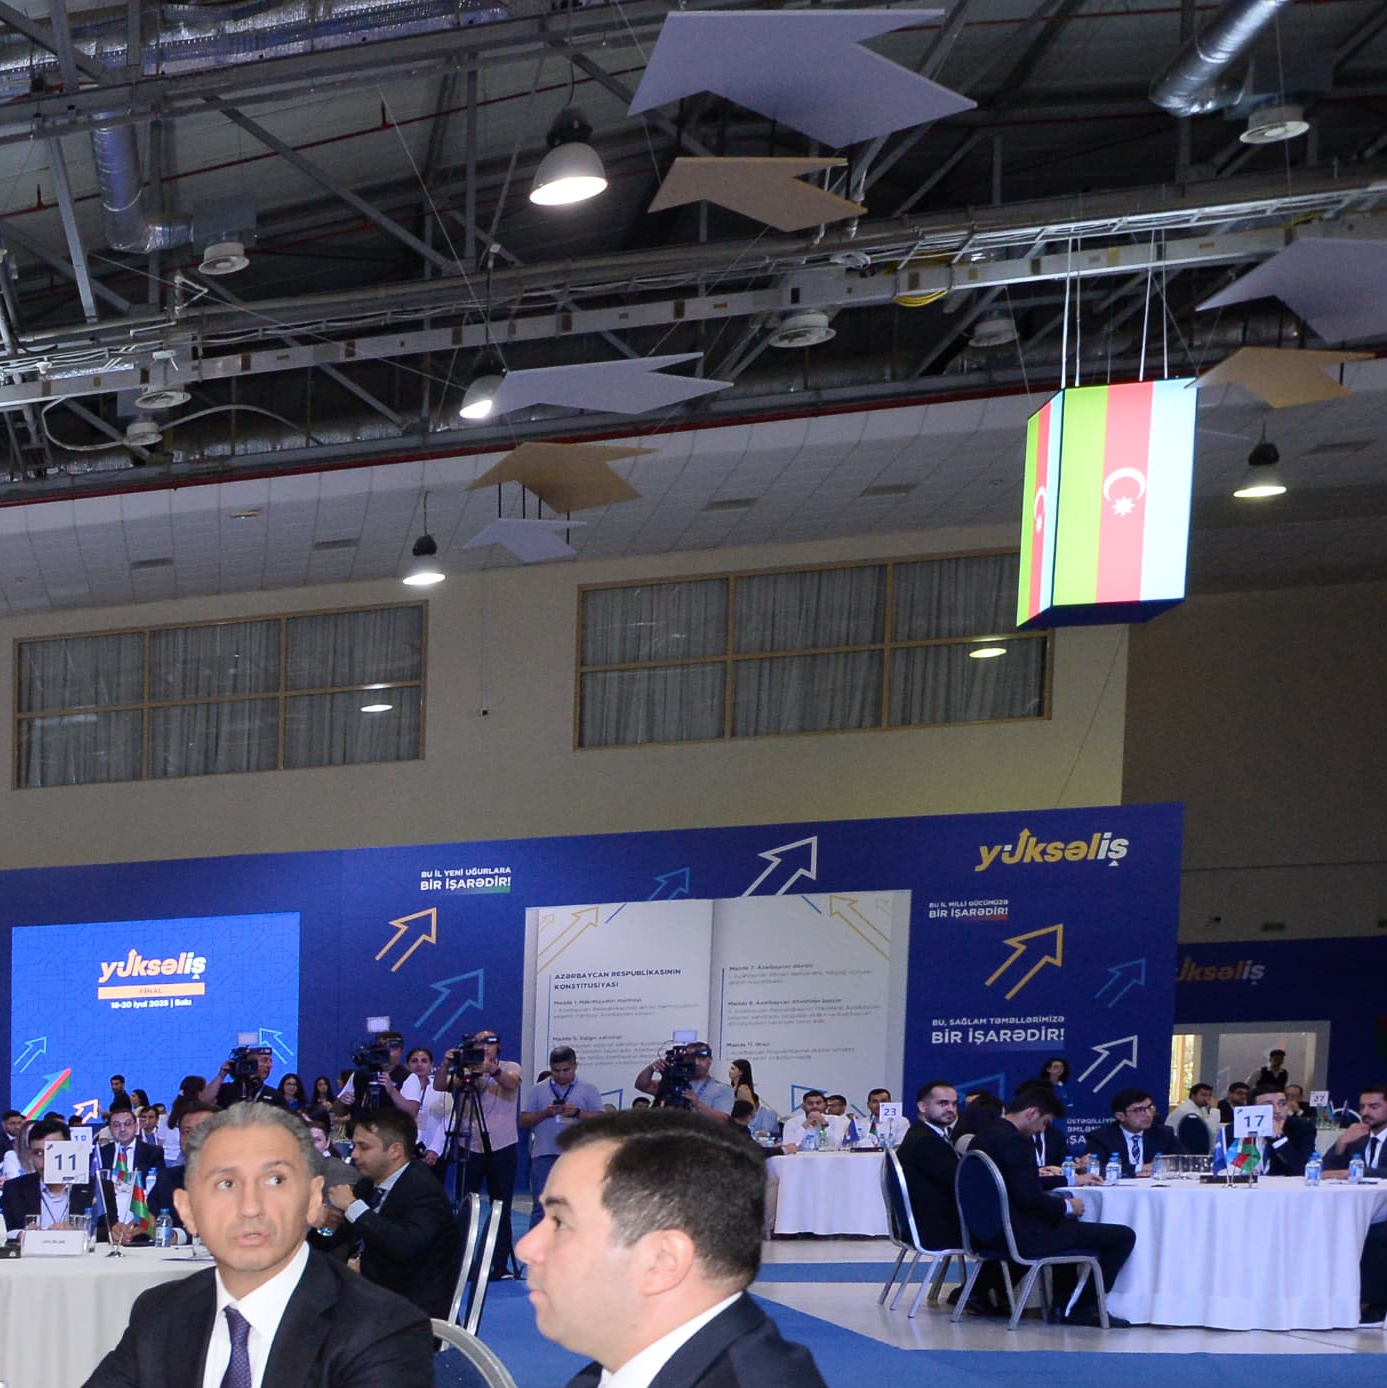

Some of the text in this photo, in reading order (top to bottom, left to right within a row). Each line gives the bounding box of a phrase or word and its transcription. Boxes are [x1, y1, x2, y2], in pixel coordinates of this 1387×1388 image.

[975, 828, 1129, 872] yüksəliş
[444, 868, 463, 877] YENİ
[466, 867, 511, 876] UĞURLARA
[421, 875, 511, 891] BİR İŞARƏDİR!
[929, 906, 1008, 919] BİR İŞARƏDİR!
[98, 948, 207, 983] yüksəliş
[555, 972, 609, 980] AZƏRBAYCAN
[949, 1017, 987, 1026] SAĞLAM
[989, 1015, 1065, 1024] TƏMƏLLƏRİMİZƏ
[931, 1026, 1065, 1045] BİR İŞARƏDİR!
[883, 1108, 897, 1116] 23
[1243, 1114, 1265, 1128] 17
[54, 1154, 76, 1170] 11
